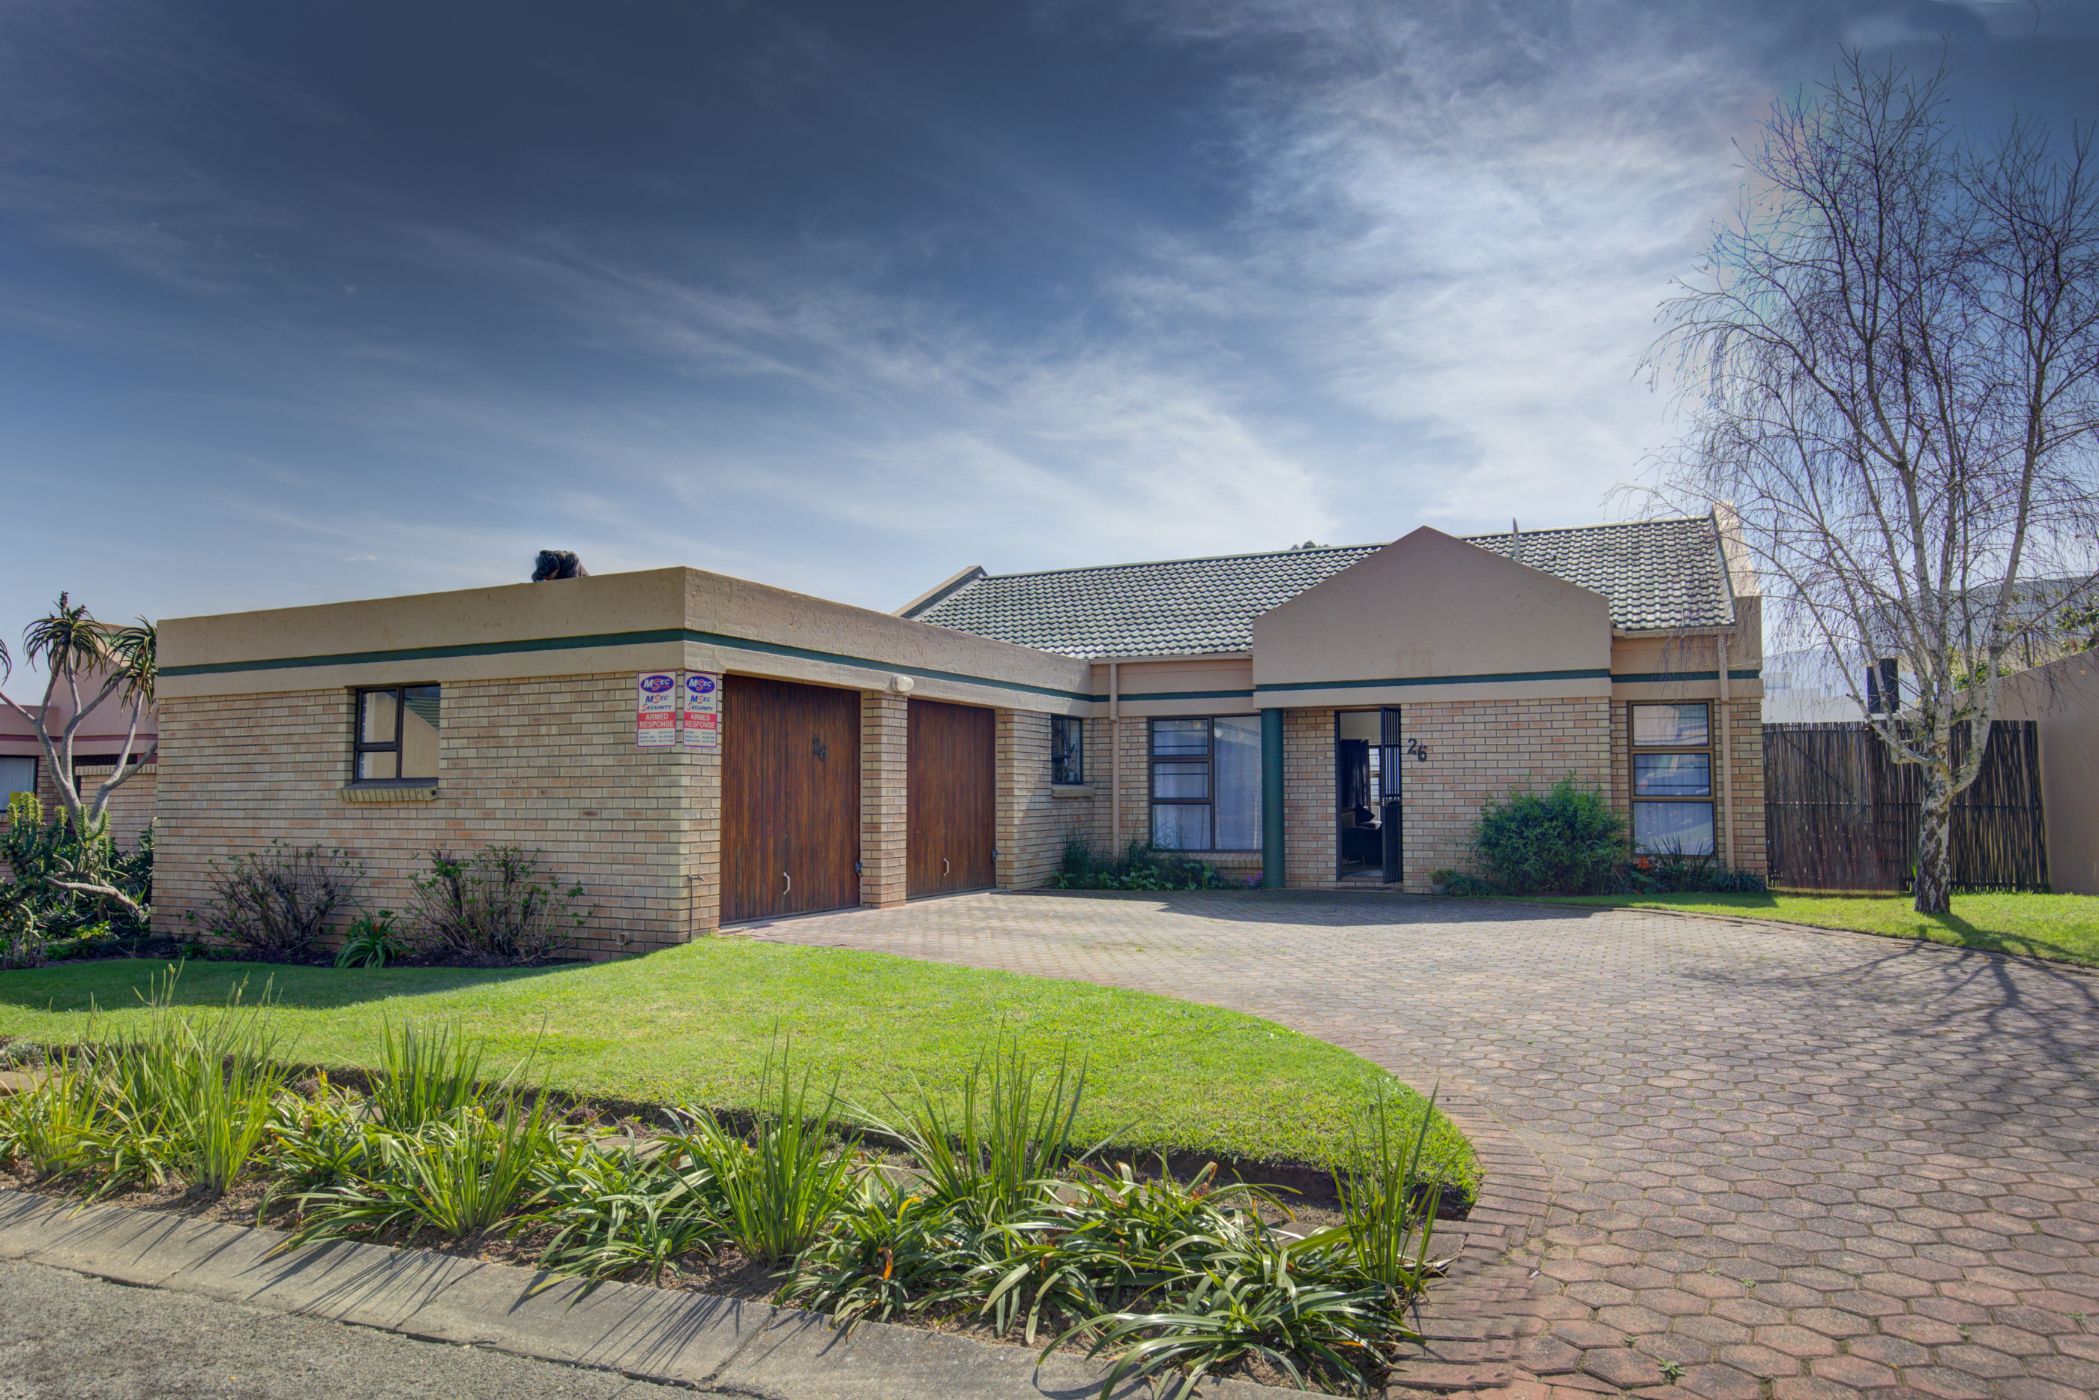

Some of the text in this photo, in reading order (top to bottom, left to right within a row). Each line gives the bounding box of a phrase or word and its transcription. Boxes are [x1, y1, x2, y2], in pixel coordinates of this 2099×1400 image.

[690, 713, 711, 721] ARMED
[639, 720, 675, 728] RESPONSE
[685, 720, 716, 728] RESPONSE
[1407, 738, 1427, 762] 26
